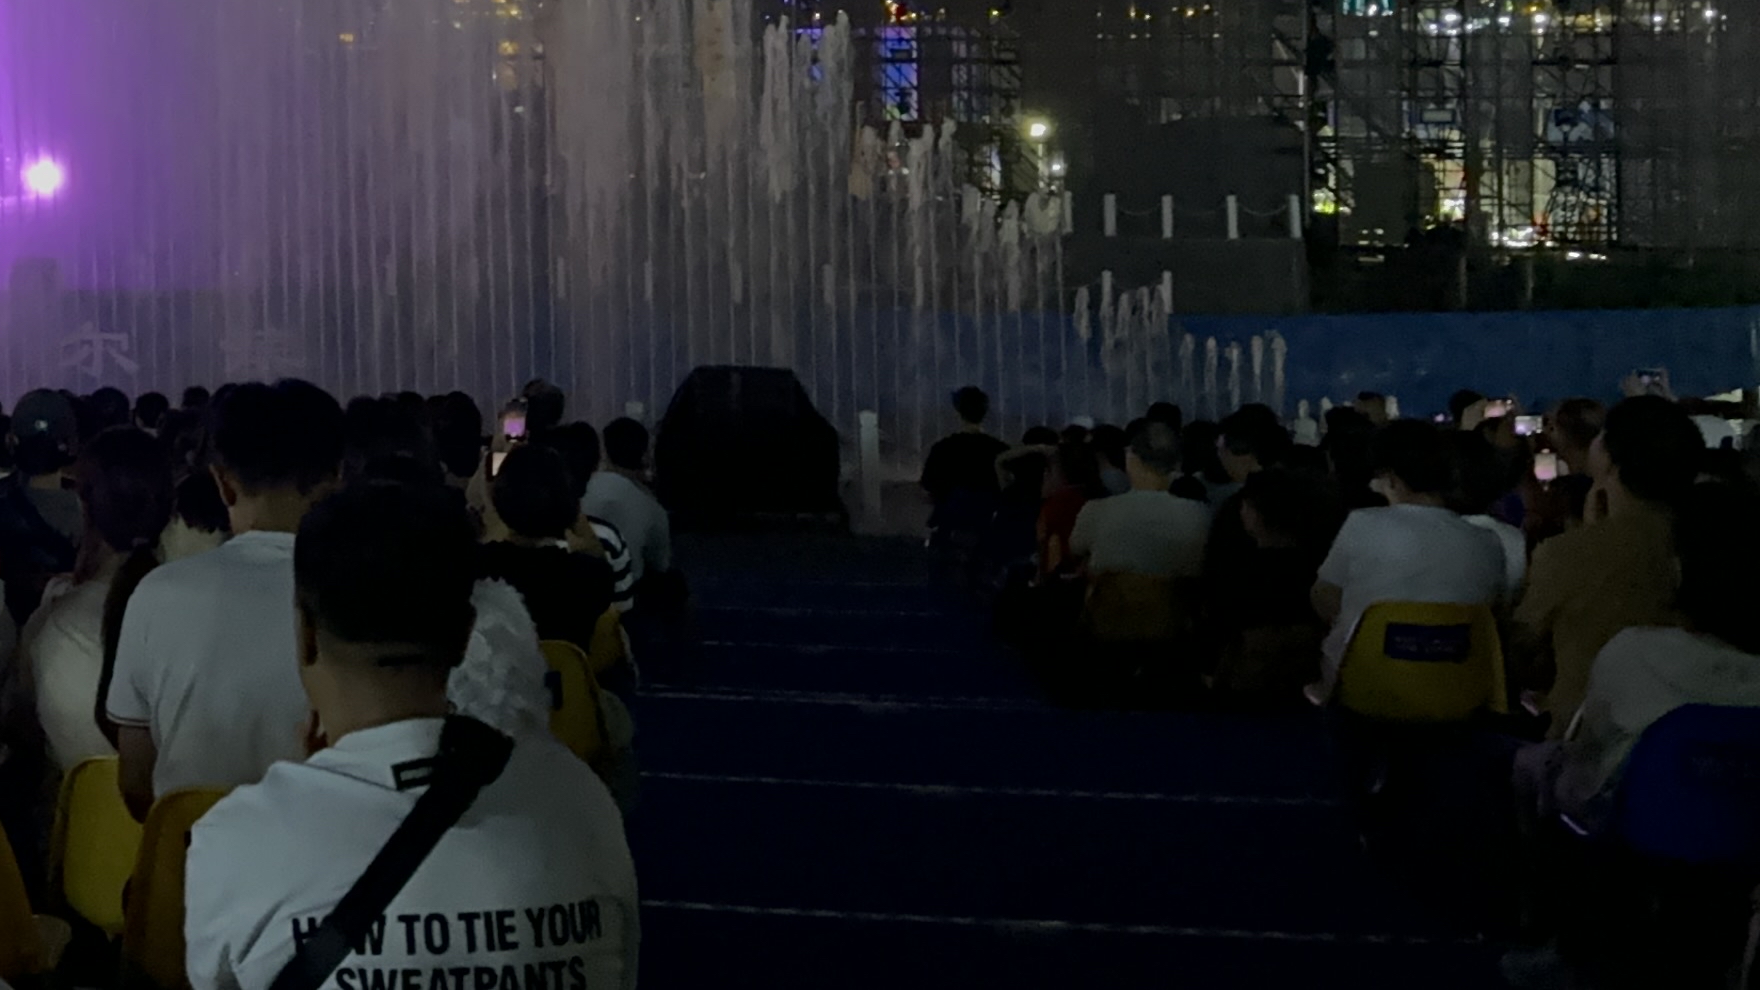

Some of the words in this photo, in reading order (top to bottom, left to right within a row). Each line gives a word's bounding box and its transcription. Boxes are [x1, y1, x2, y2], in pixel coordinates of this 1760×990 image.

[292, 913, 386, 955] HW
[398, 913, 450, 955] TO
[457, 910, 519, 953] TIE
[525, 899, 603, 948] YOUR
